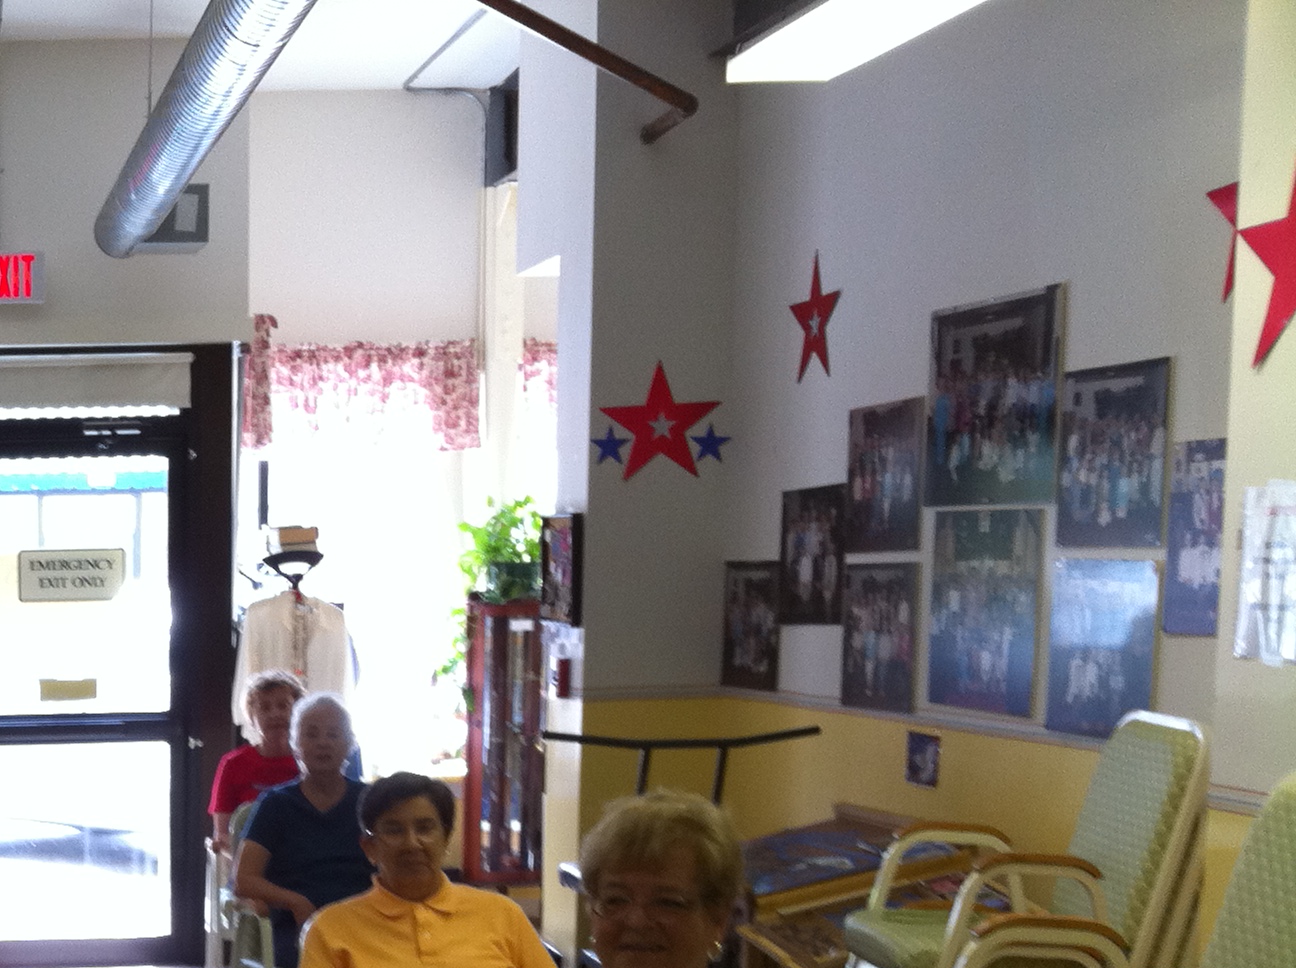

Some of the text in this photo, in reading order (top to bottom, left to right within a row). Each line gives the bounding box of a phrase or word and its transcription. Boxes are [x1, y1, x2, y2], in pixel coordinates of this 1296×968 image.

[27, 558, 116, 571] EMERGENCY
[38, 576, 108, 588] EXIT ONLY
